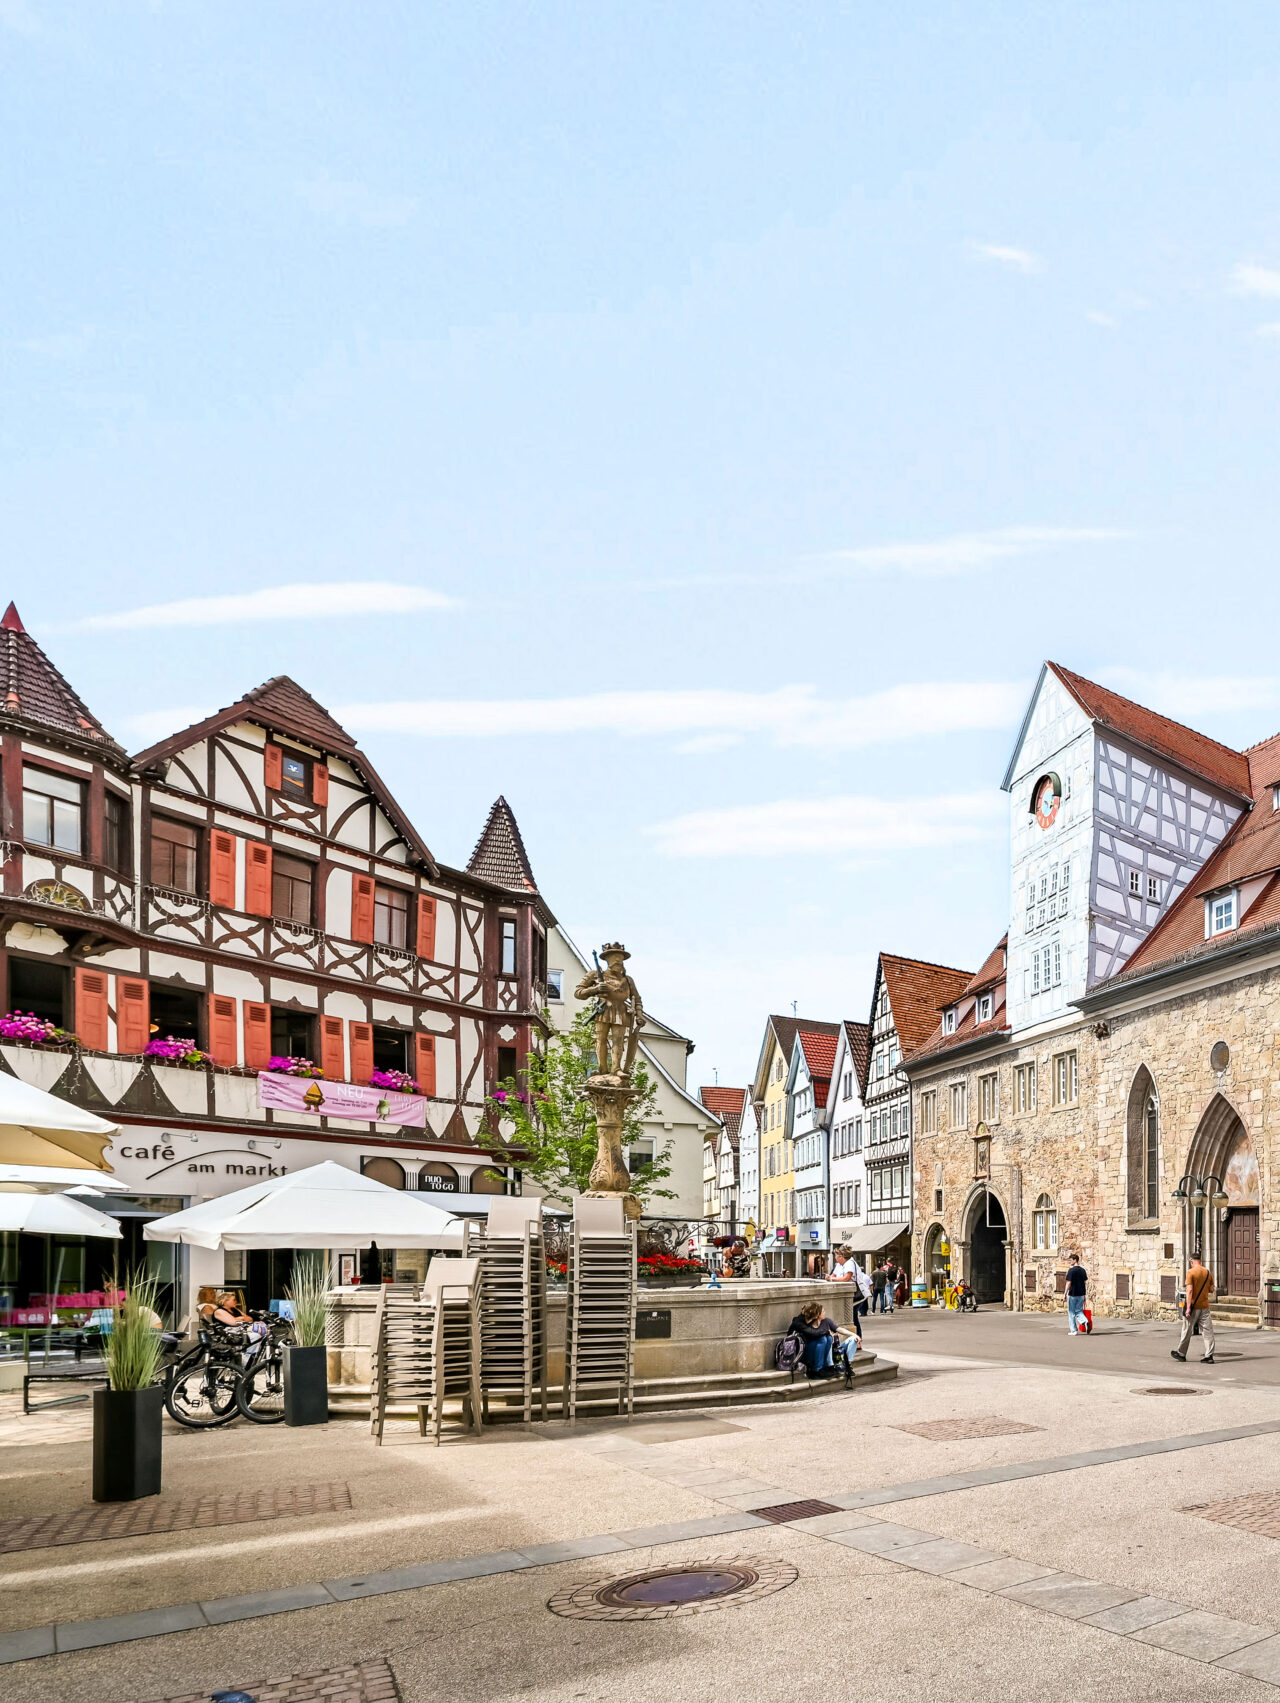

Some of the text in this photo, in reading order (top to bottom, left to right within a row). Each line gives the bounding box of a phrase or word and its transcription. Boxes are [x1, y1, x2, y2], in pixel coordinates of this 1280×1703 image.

[337, 1086, 364, 1099] NEU
[120, 1144, 175, 1160] café
[188, 1163, 288, 1176] am markt
[442, 1183, 454, 1191] GO
